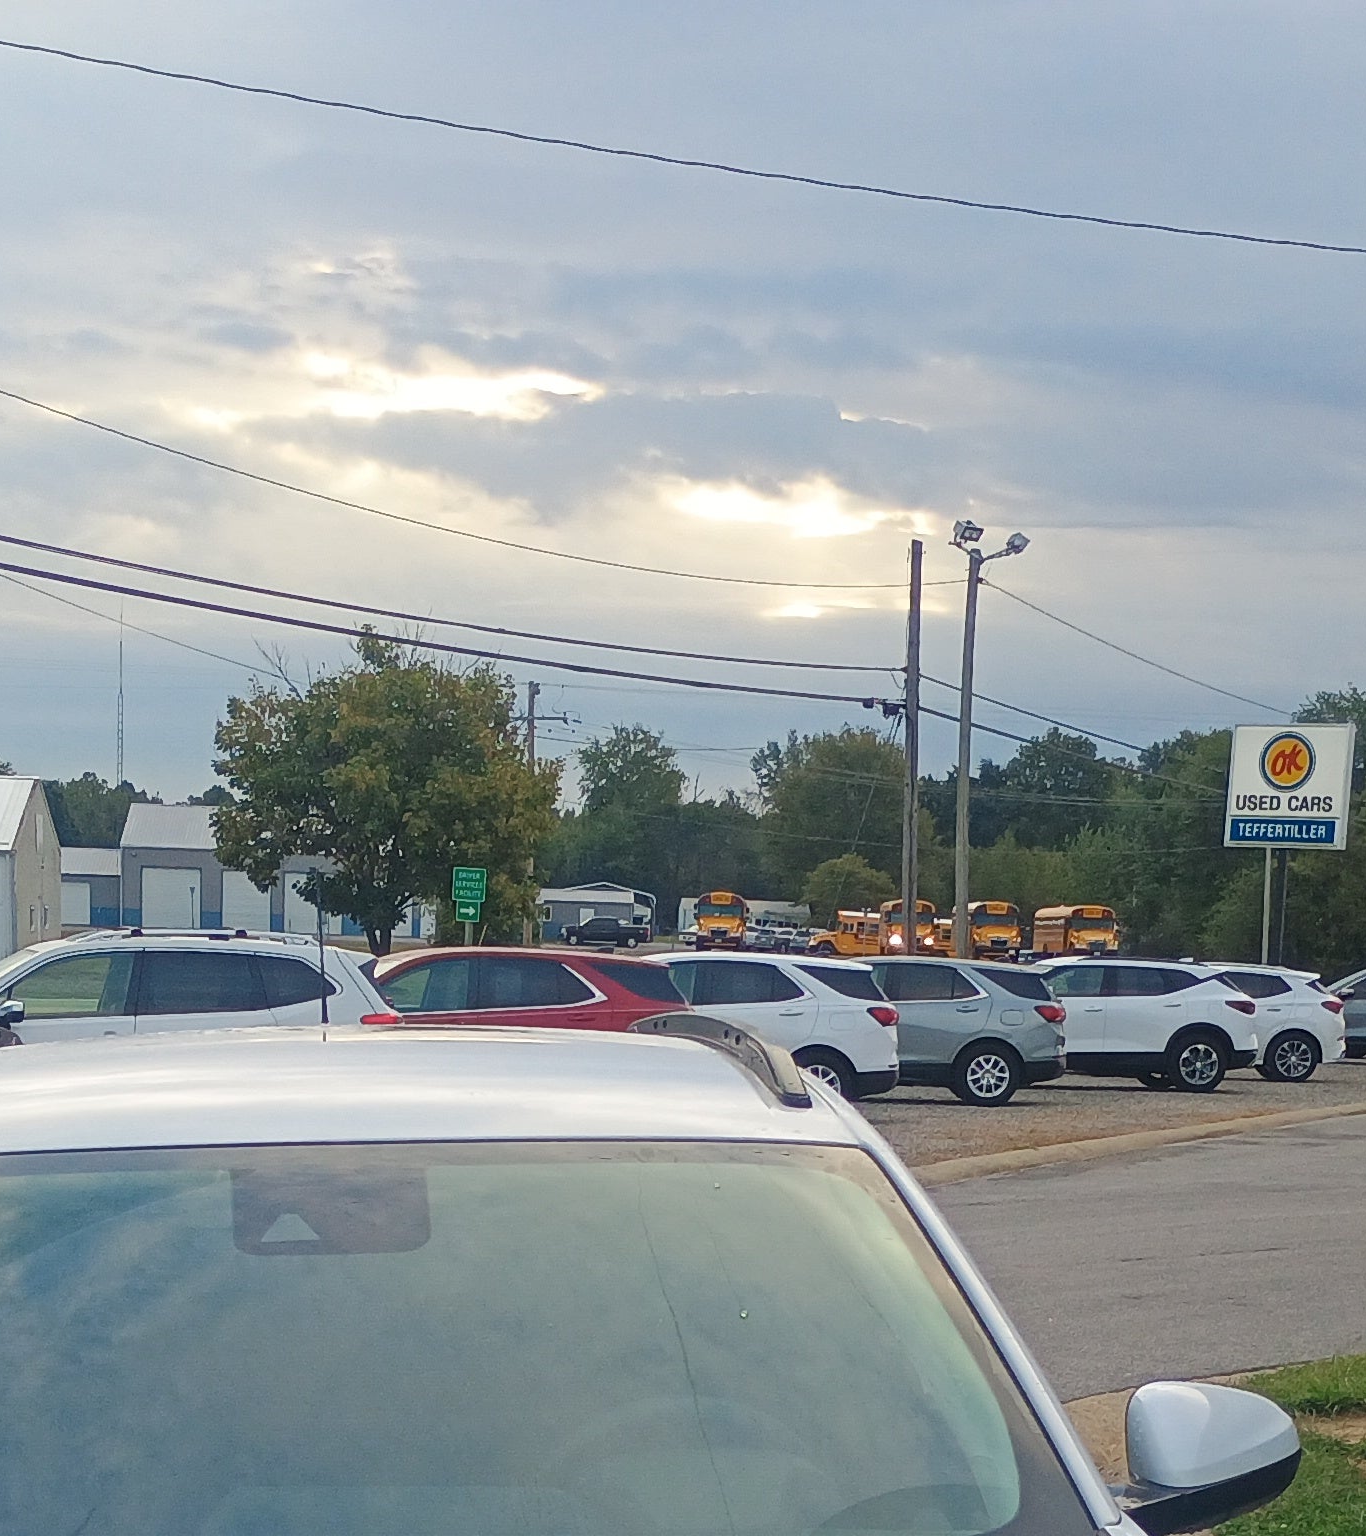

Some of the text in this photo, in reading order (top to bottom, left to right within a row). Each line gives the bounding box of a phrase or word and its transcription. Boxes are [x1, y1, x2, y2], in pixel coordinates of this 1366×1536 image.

[1270, 743, 1304, 777] OK
[1235, 795, 1333, 812] USED CARS
[1239, 822, 1326, 838] TEFFERTILLER
